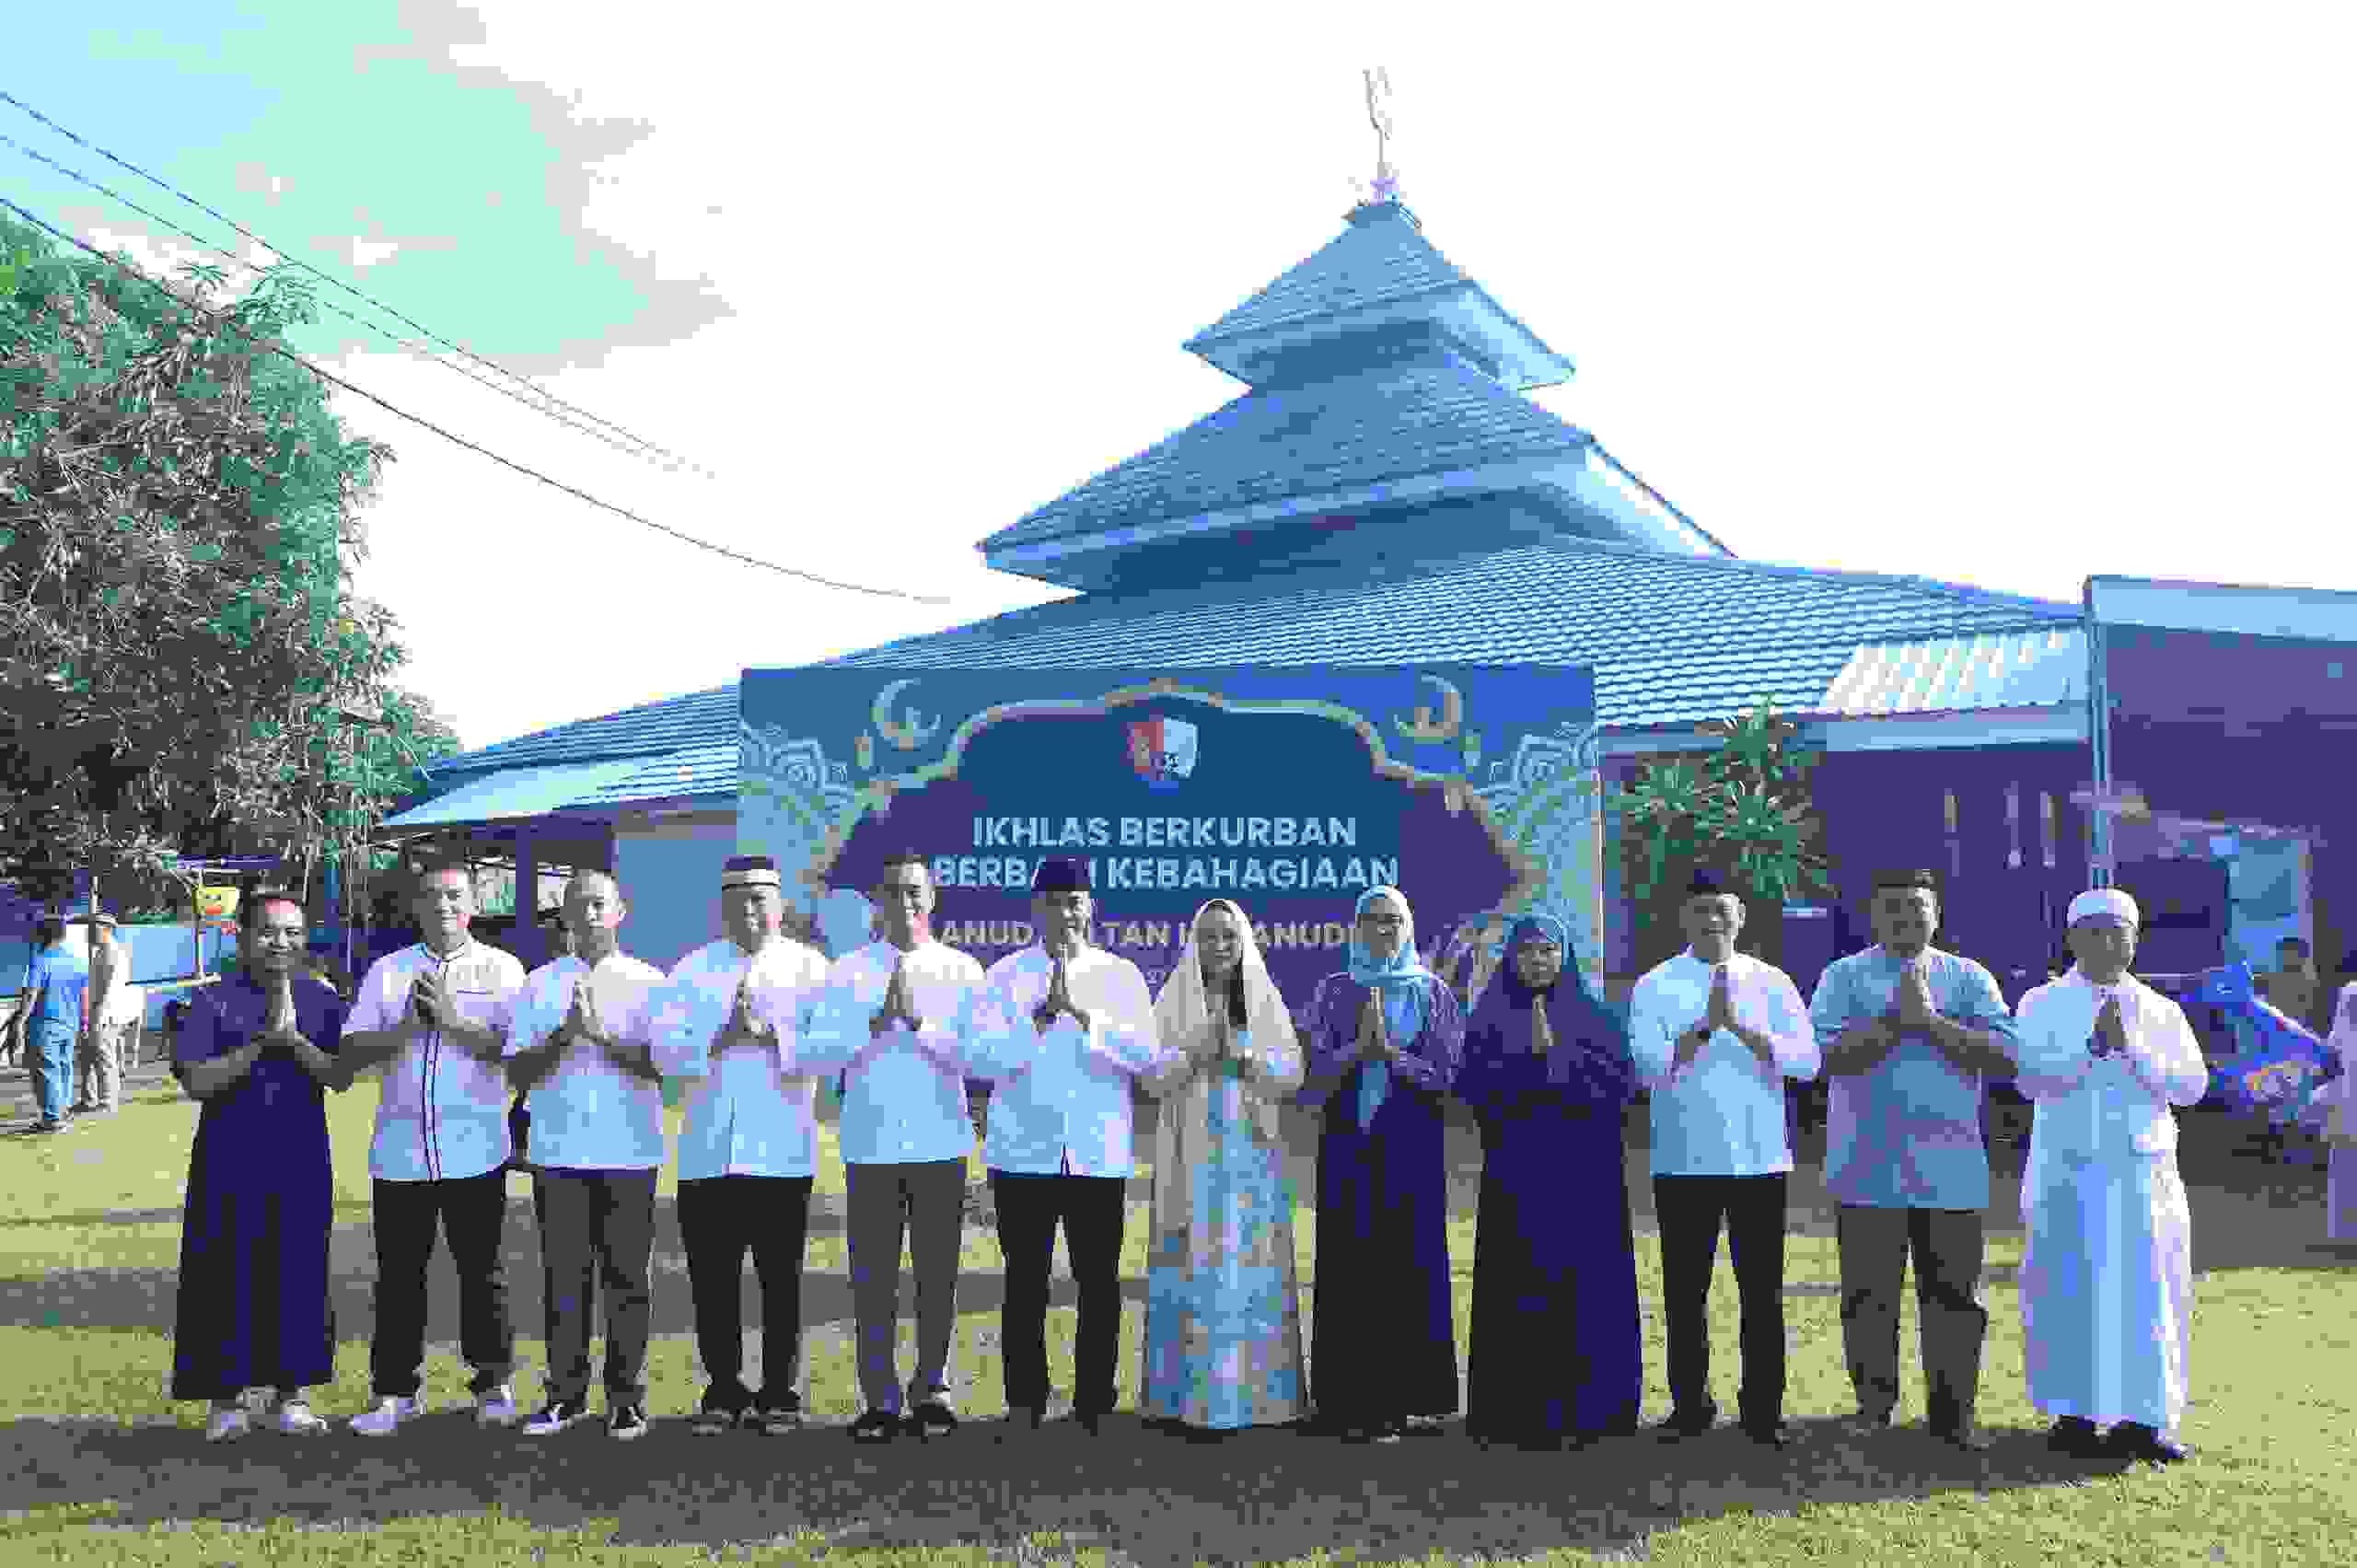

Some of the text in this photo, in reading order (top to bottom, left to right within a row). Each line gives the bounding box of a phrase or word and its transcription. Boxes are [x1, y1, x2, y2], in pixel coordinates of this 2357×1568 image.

[972, 817, 1357, 847] IKHLAS BERKURBAN
[933, 856, 1399, 889] BERBI KEBAHAGIAAN
[940, 921, 1032, 947] ANUD
